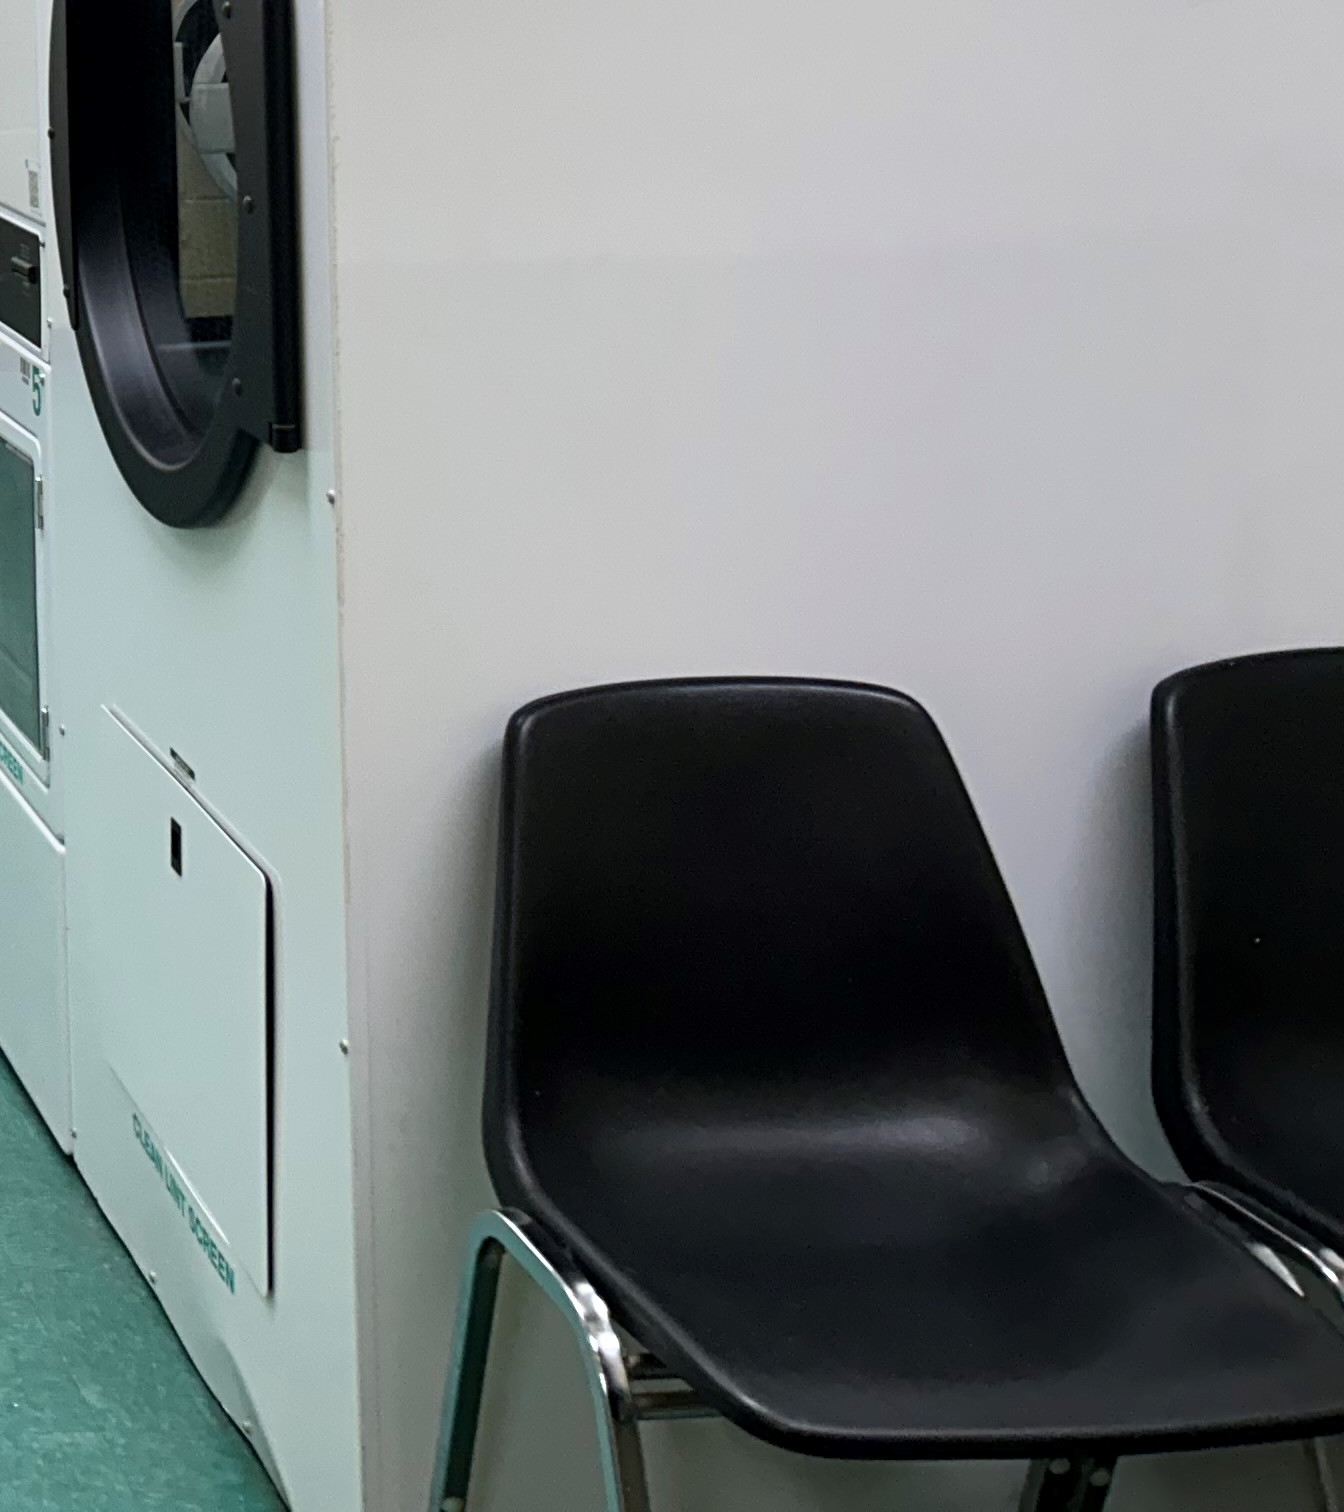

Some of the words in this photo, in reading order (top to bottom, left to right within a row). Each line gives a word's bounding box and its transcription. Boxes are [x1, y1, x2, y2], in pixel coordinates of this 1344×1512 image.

[31, 365, 43, 417] 5
[132, 1112, 164, 1179] CLEAN
[164, 1161, 186, 1218] LINT
[188, 1204, 236, 1296] SCREEN
